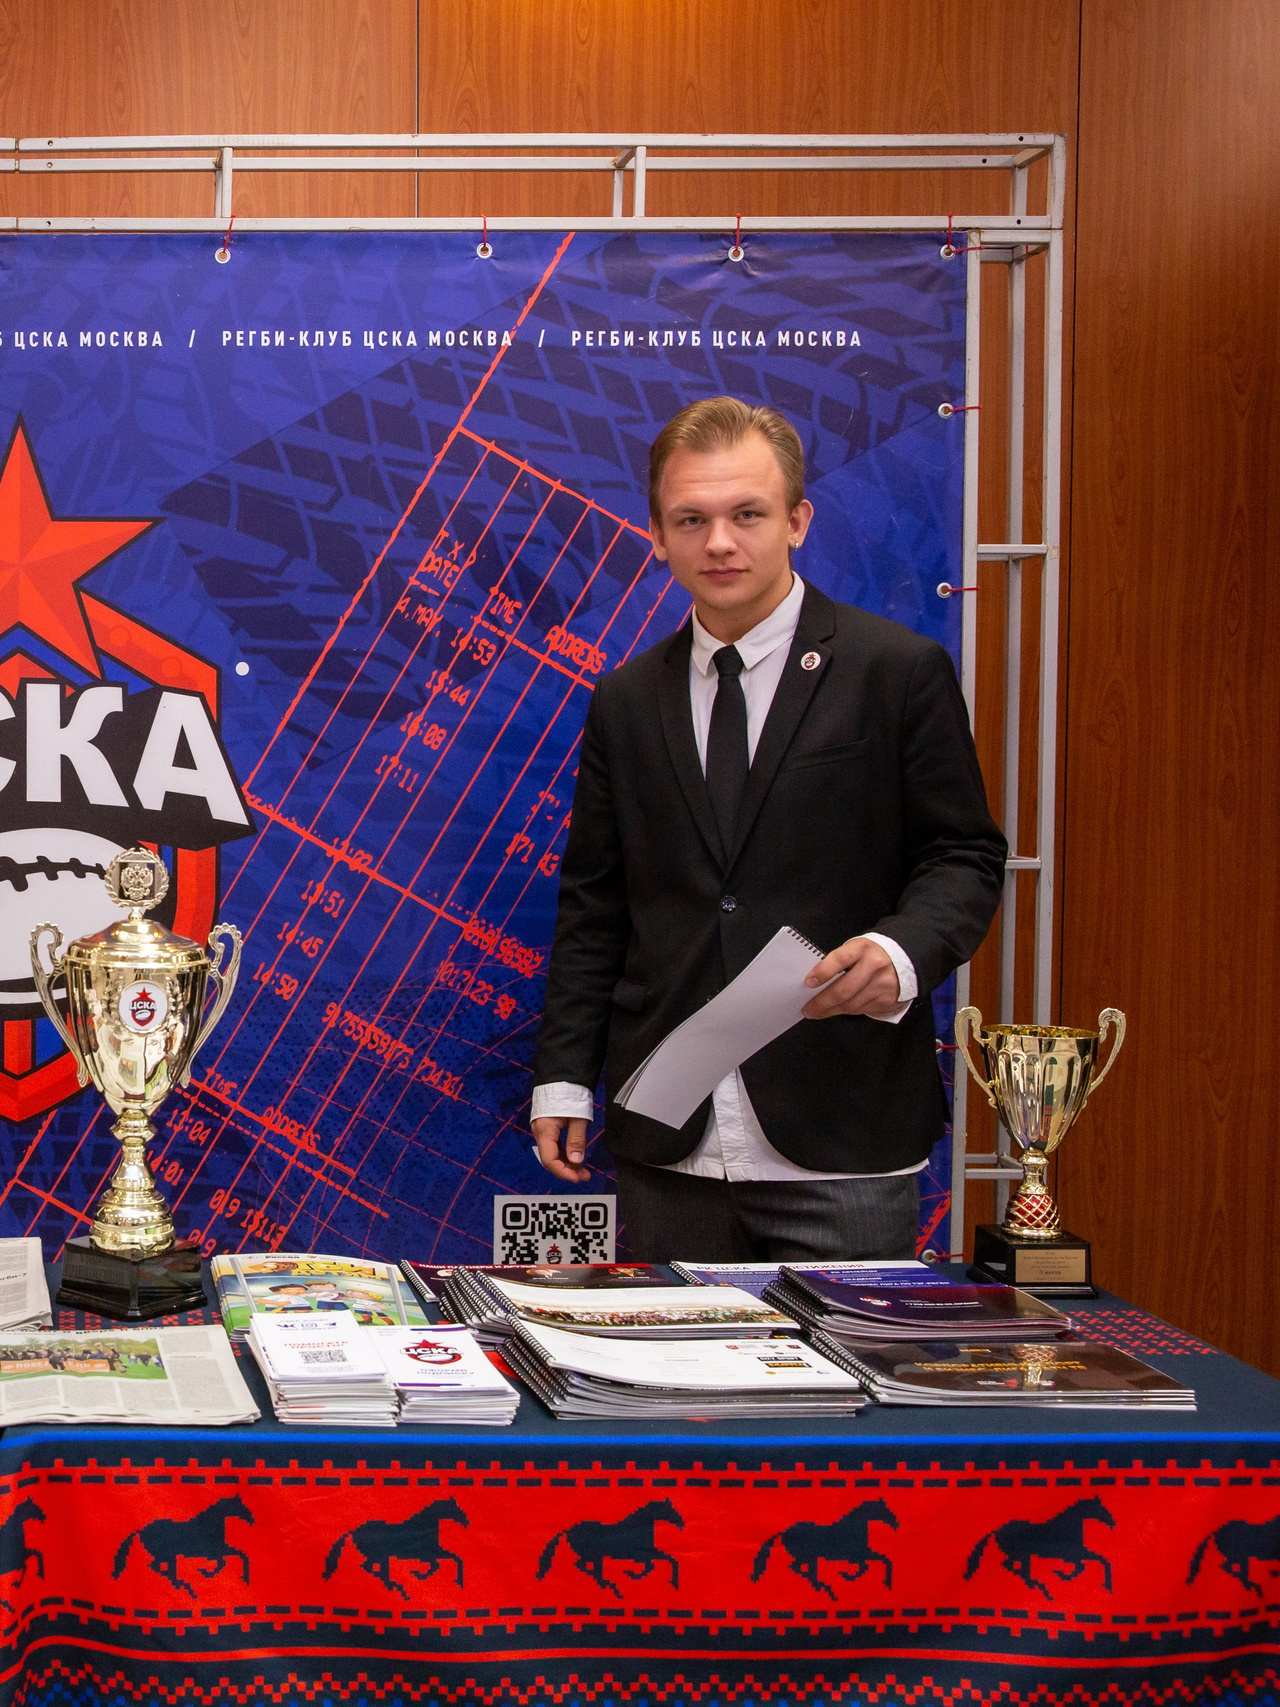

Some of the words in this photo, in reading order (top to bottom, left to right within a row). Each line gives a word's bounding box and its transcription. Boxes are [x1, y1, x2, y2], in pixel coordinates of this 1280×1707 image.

[14, 331, 69, 350] ЦСКА
[79, 330, 163, 347] МОСКВА
[222, 330, 352, 347] РЕГБИ-КЛУБ
[363, 330, 418, 350] ЦСКА
[428, 330, 512, 347] МОСКВА
[571, 330, 701, 347] РЕГБИ-КЛУБ
[712, 330, 767, 350] ЦСКА
[777, 330, 861, 347] МОСКВА
[420, 549, 461, 588] DATE
[129, 1000, 157, 1012] ЦСКА
[400, 1347, 465, 1355] ЦСКА
